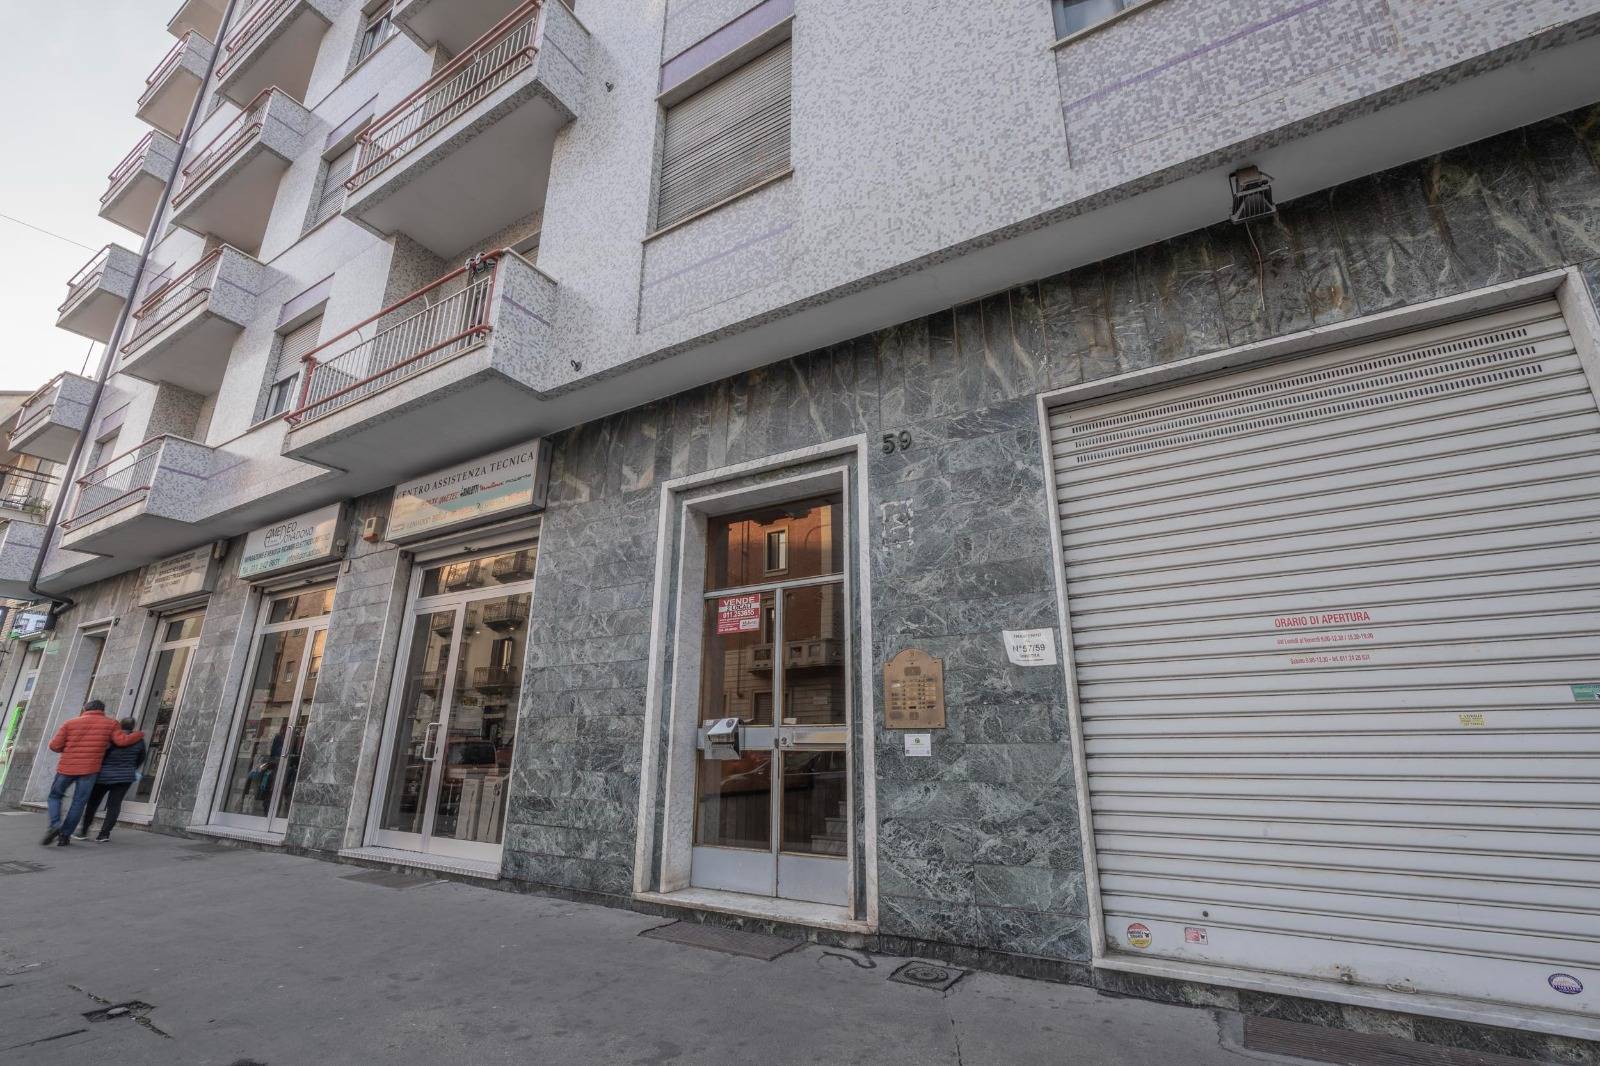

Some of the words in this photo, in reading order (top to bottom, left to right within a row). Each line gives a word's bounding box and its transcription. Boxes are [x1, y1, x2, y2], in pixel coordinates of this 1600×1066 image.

[881, 430, 912, 454] 59
[396, 483, 430, 500] CENTRO
[432, 467, 487, 491] ASSISTENZA
[490, 451, 534, 473] TECNICA
[723, 596, 756, 606] VENDE
[1274, 615, 1308, 628] ORARIO
[1310, 614, 1320, 625] DI
[1322, 611, 1371, 624] APERTURA
